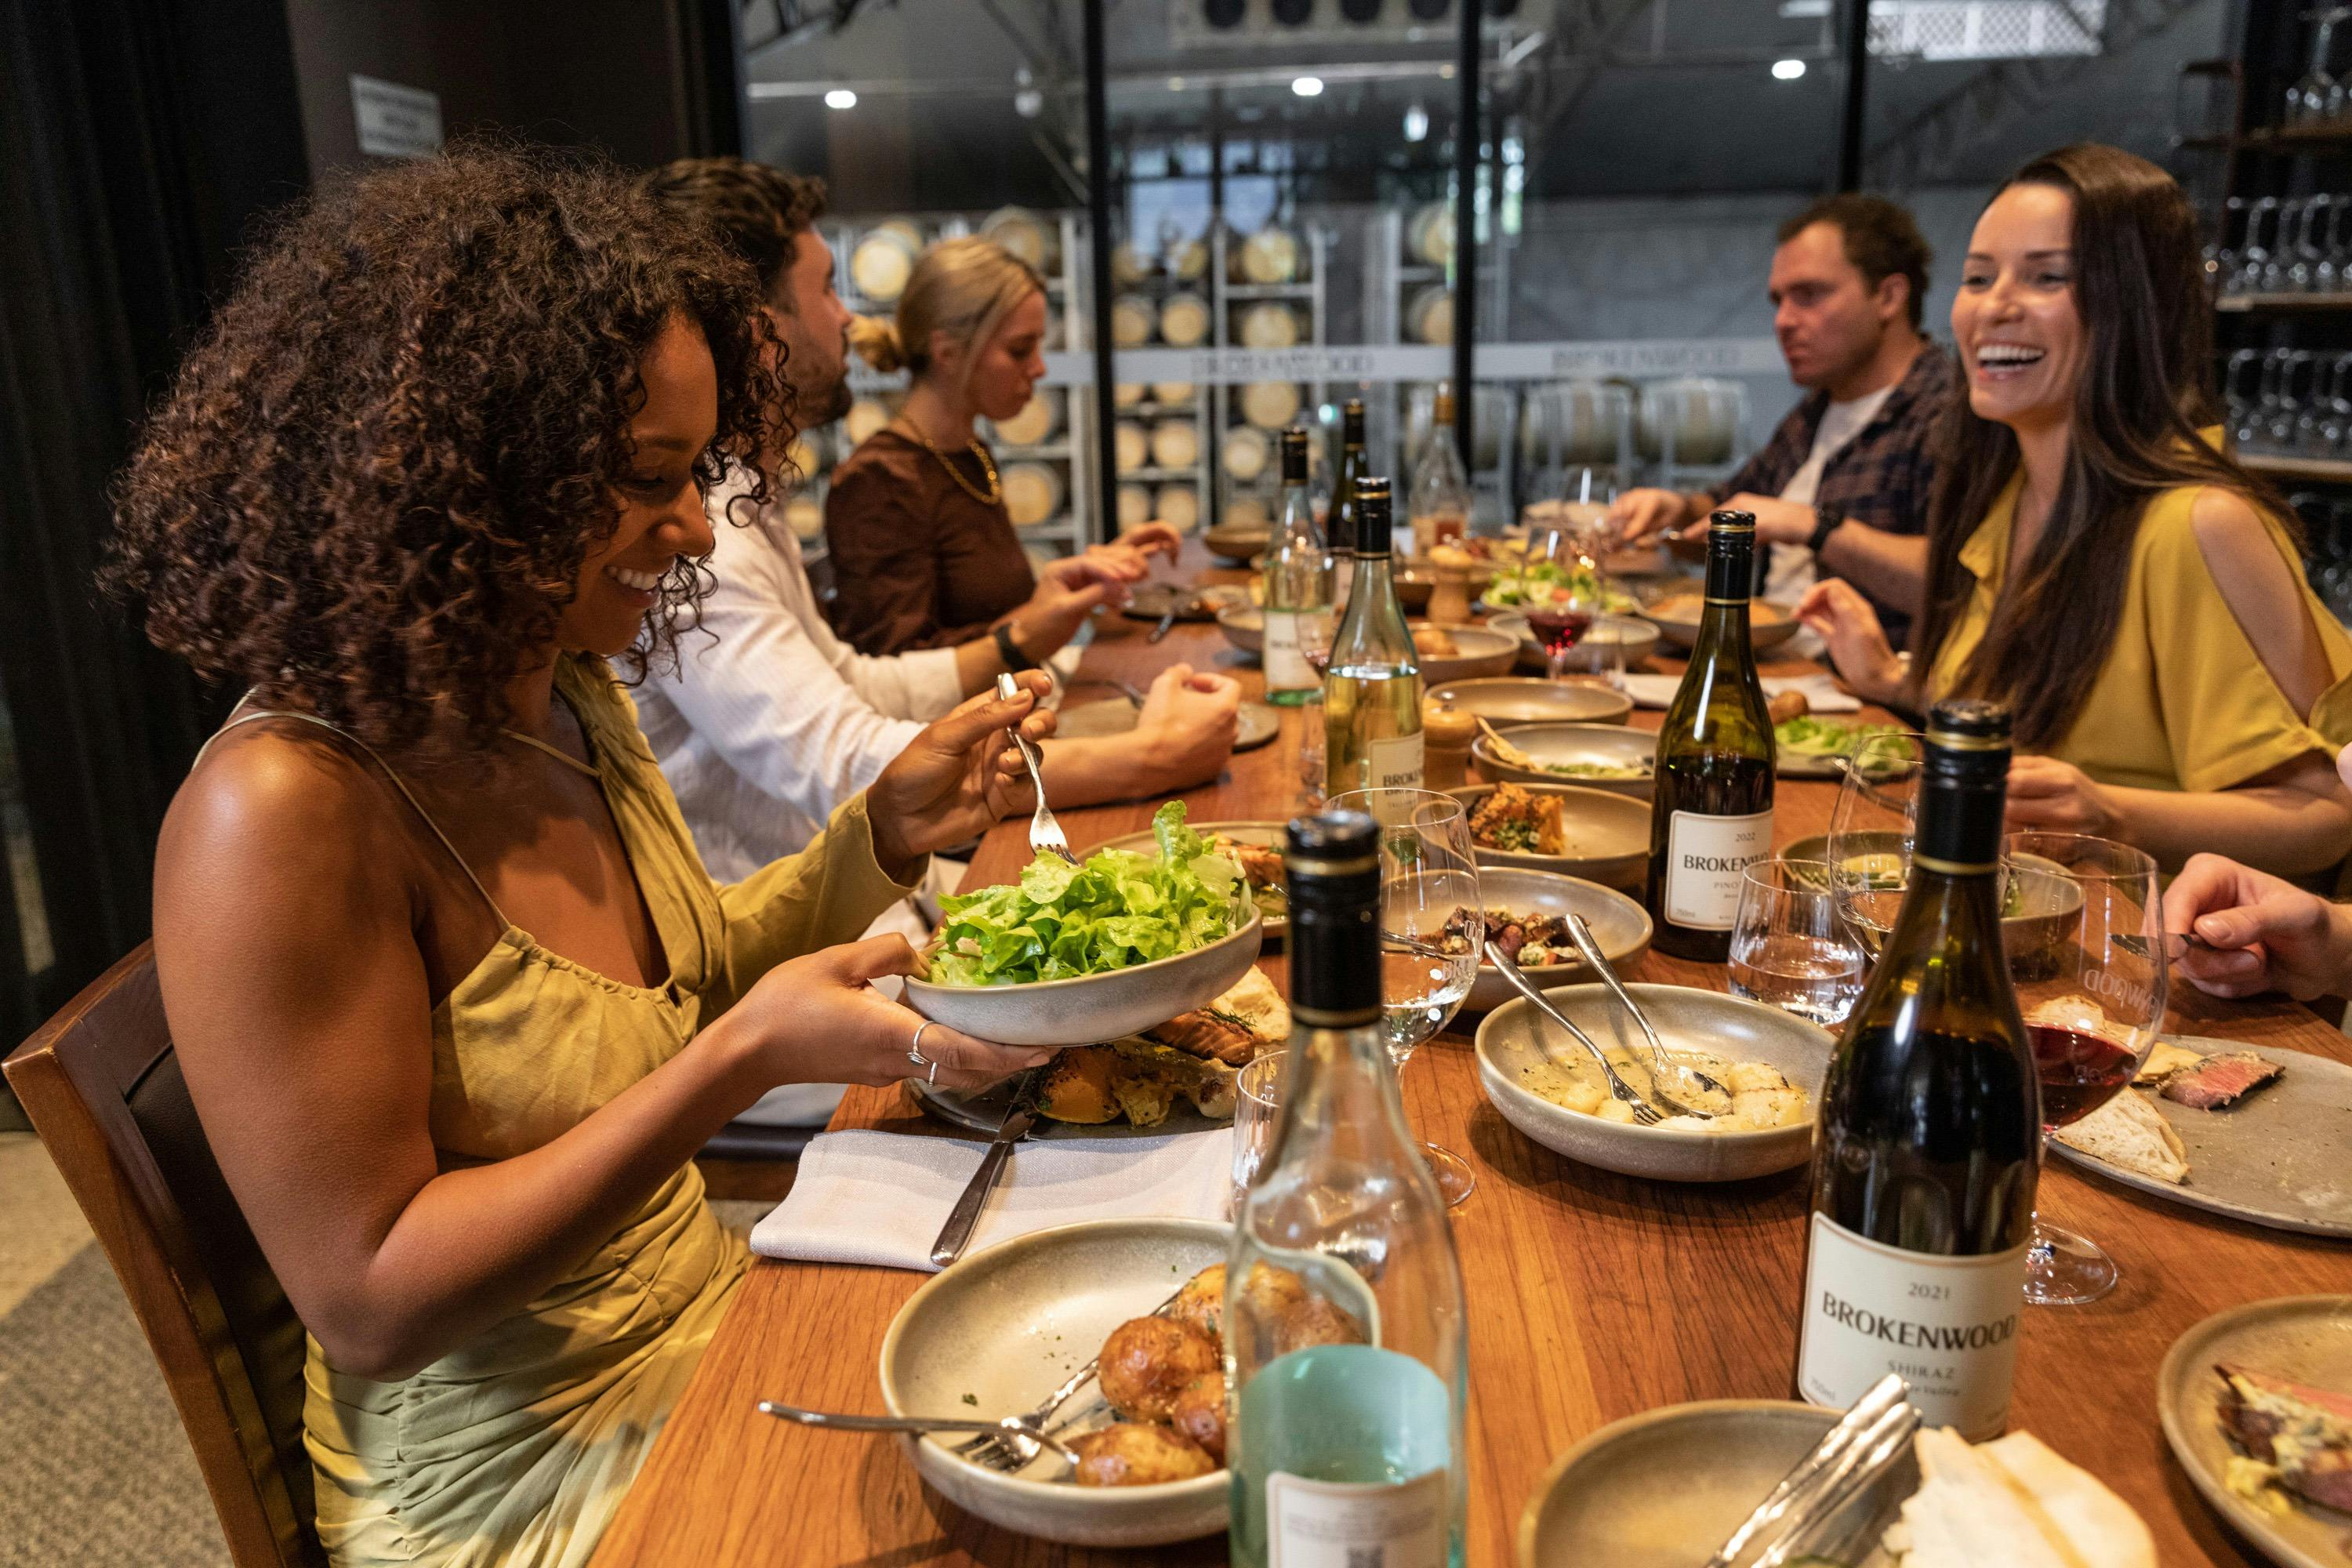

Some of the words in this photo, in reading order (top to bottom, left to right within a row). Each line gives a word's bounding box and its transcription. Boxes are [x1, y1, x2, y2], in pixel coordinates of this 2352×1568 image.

[1907, 1282, 1951, 1299] 2021
[1823, 1291, 2016, 1350] BROKENWOOD
[1888, 1360, 1955, 1380] SHIRAZ
